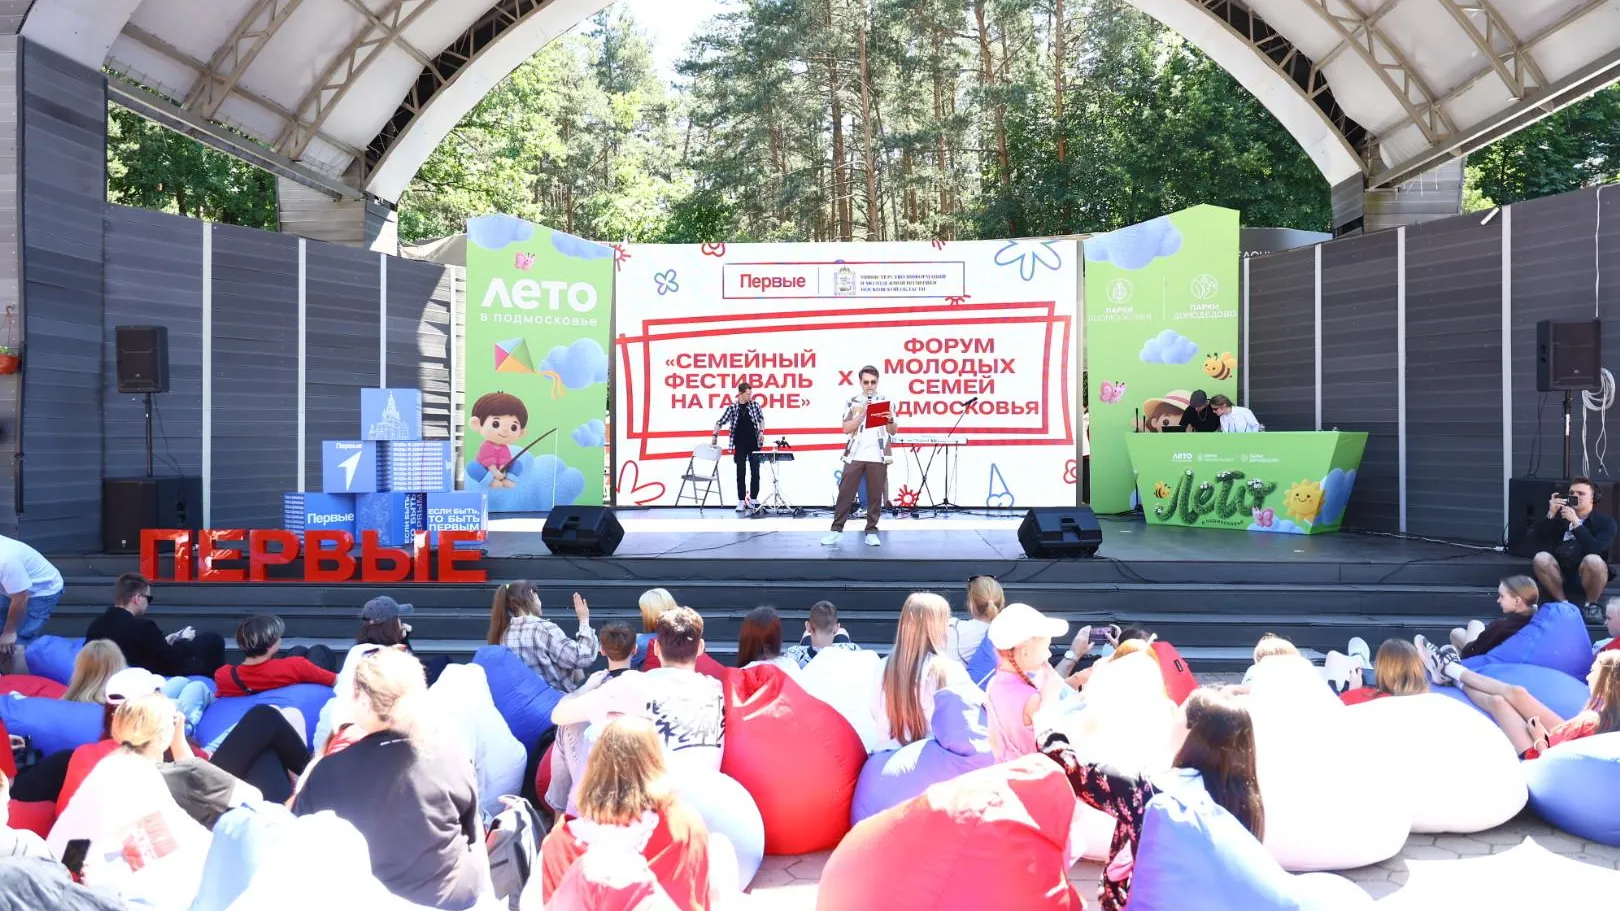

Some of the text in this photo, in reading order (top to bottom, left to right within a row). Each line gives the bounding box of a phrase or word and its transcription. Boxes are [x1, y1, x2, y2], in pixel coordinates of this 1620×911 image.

[740, 274, 806, 292] Первые
[1106, 307, 1134, 315] ПАРКИ
[1190, 303, 1219, 311] ПАРКИ
[903, 337, 995, 354] ФОРУМ
[665, 348, 817, 369] «СЕМЕЙНЫЙ
[884, 358, 1016, 377] МОЛОДЫХ
[664, 372, 813, 390] ФЕСТИВАЛЬ
[908, 375, 995, 395] СЕМЕЙ
[671, 393, 811, 409] НА ГАОНЕ»
[896, 400, 1039, 418] ДМОСКОВЬЯ
[336, 442, 363, 450] Первые
[307, 512, 355, 526] Первые
[428, 515, 480, 523] ТО БЫТЬ
[453, 508, 480, 516] БЫТЬ,
[429, 523, 480, 532] ПЕРВЫМ
[139, 529, 489, 583] ПЕРВЫЕ
